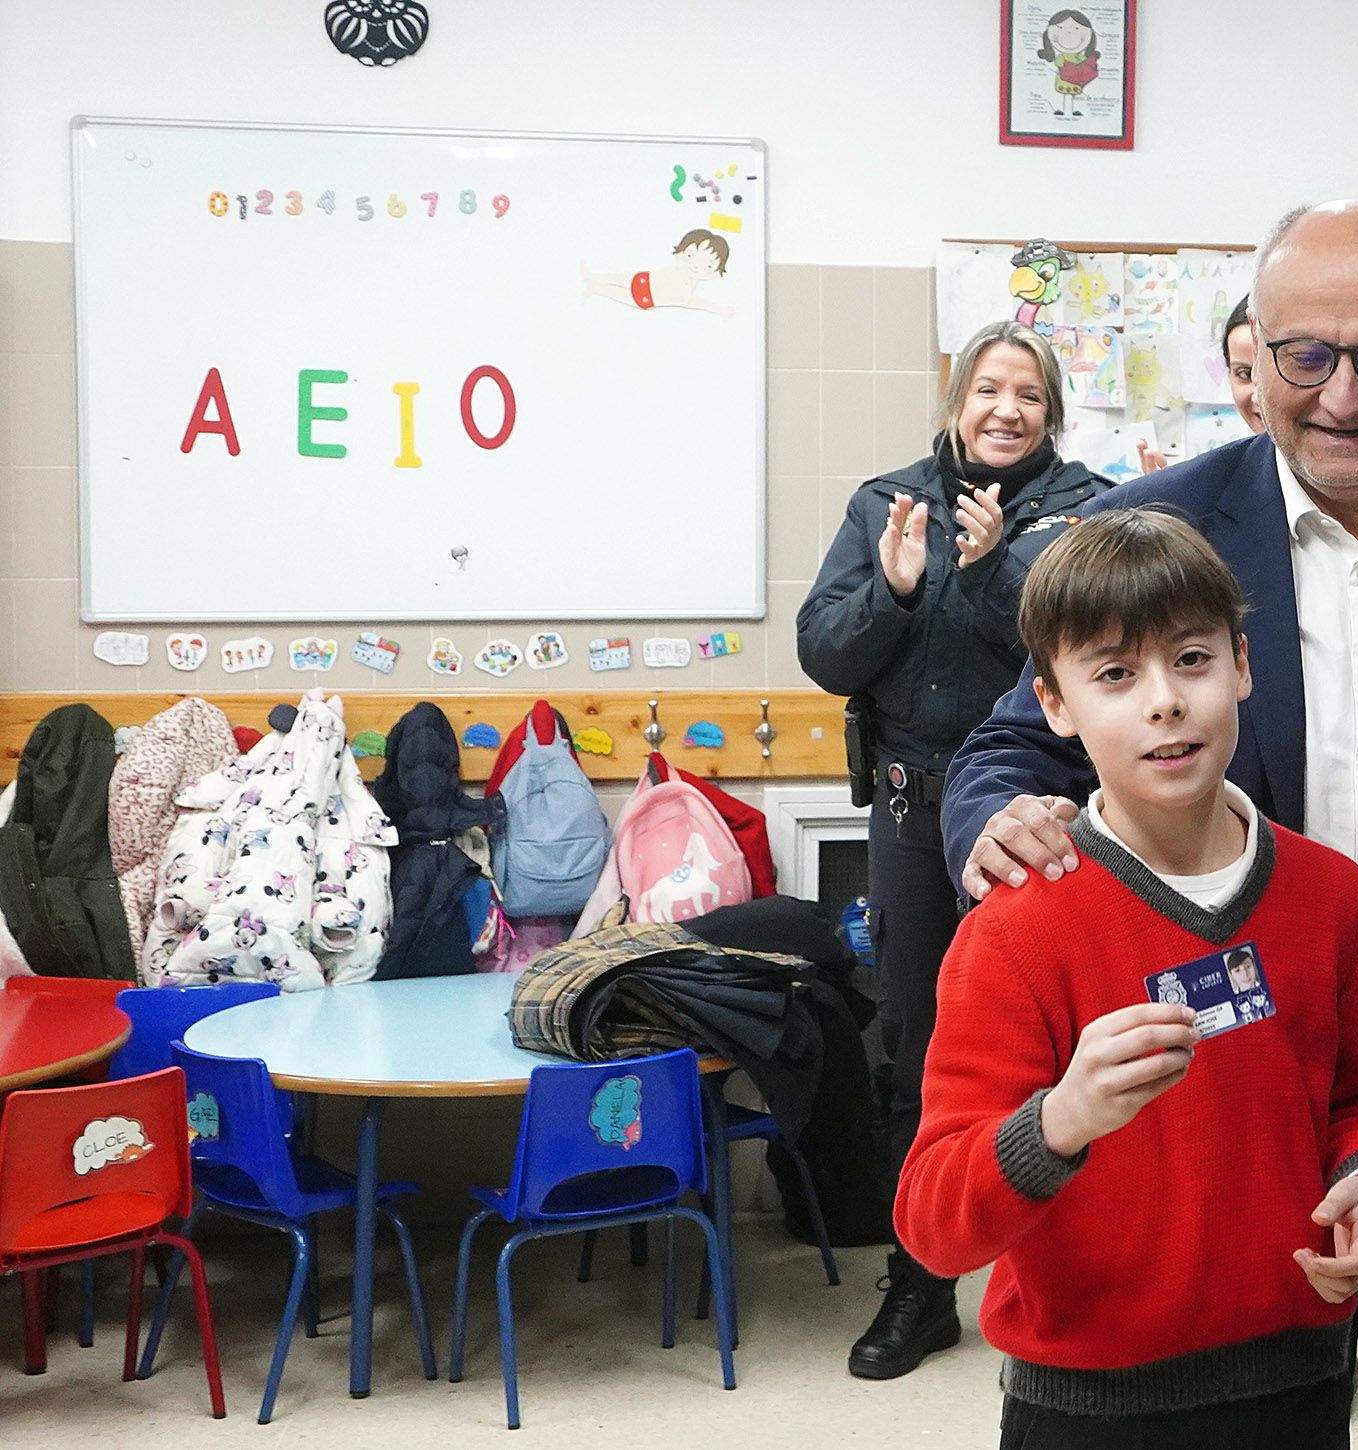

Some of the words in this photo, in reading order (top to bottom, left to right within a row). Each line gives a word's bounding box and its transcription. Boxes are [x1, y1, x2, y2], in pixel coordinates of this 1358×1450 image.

[180, 367, 241, 457] A
[297, 368, 349, 459] E
[391, 382, 423, 469] I
[460, 365, 517, 450] O
[82, 1131, 129, 1158] CLOE
